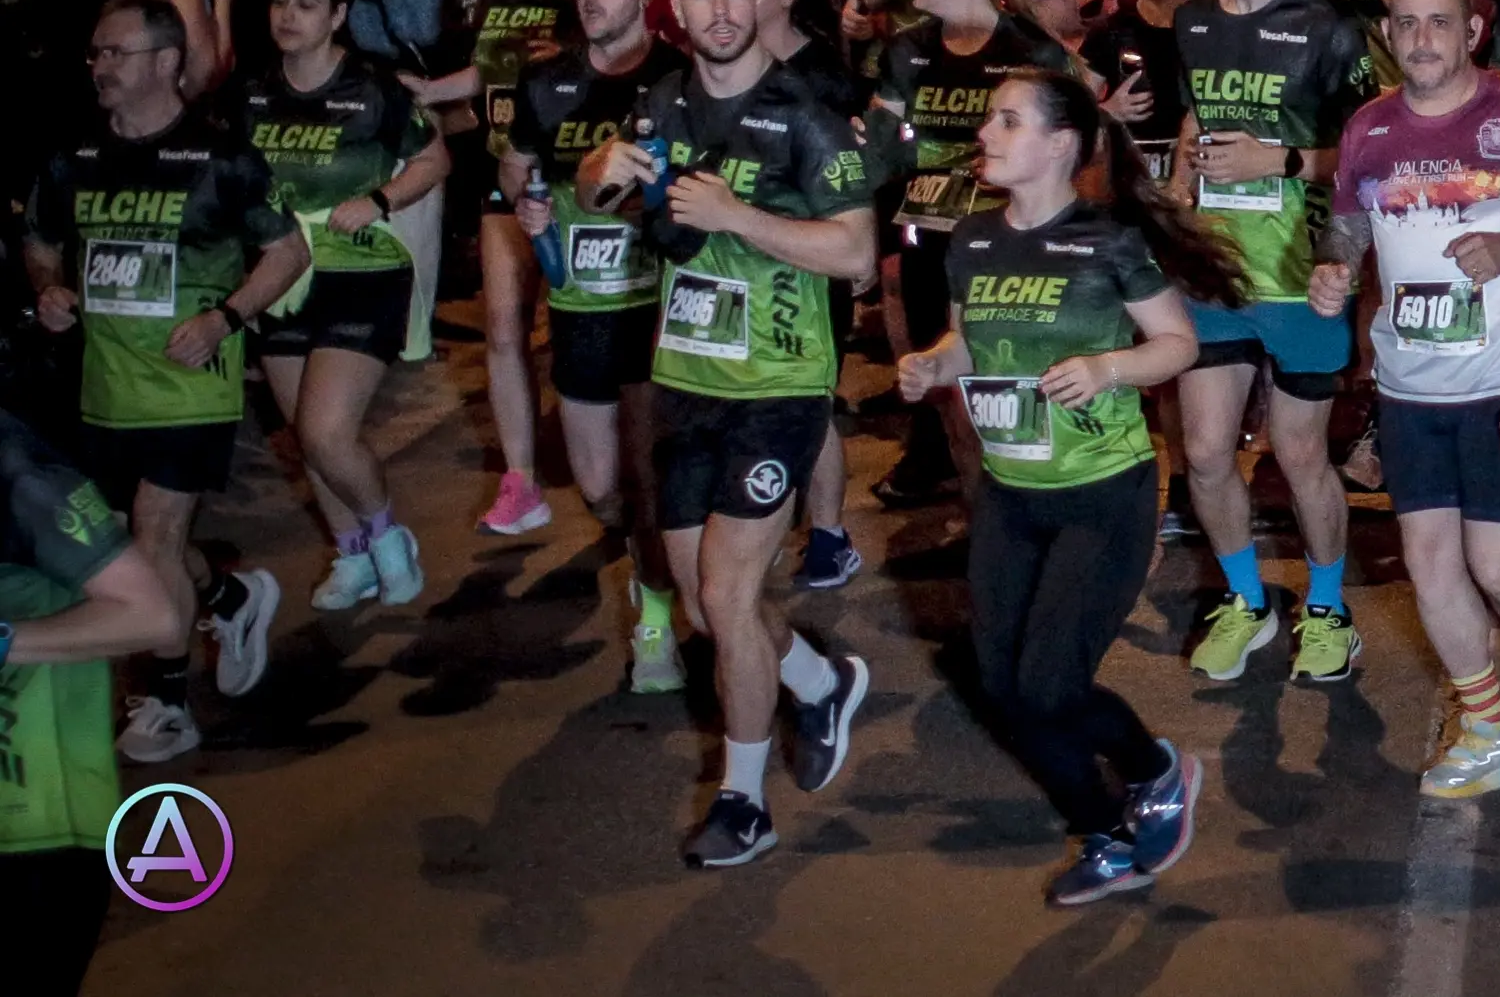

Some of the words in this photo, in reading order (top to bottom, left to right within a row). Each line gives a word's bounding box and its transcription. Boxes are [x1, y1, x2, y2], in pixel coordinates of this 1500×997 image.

[482, 5, 560, 29] ELCHE
[914, 85, 995, 113] ELCH
[1191, 68, 1288, 106] ELCHE
[250, 123, 344, 151] ELCHE
[74, 189, 189, 225] ELCHE
[965, 274, 1069, 306] ELCHE
[1396, 294, 1454, 329] 5910
[971, 392, 1020, 429] 3000
